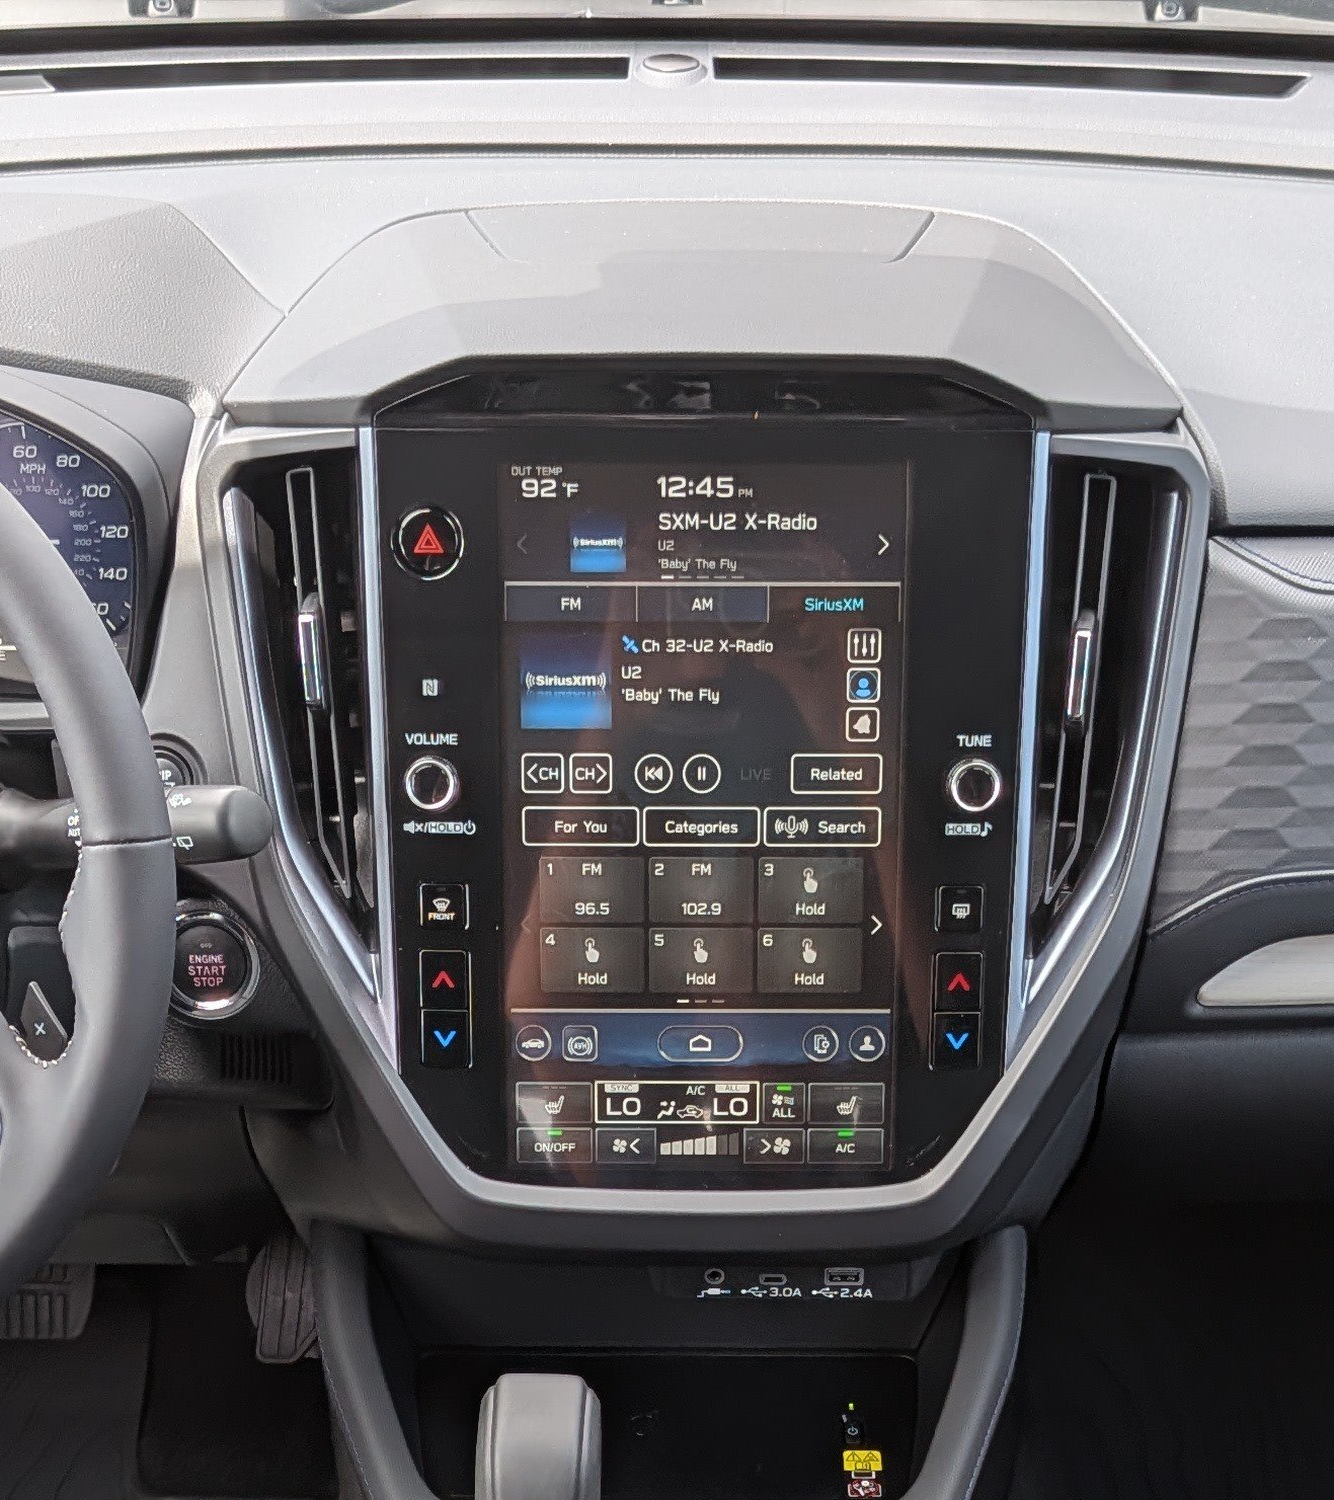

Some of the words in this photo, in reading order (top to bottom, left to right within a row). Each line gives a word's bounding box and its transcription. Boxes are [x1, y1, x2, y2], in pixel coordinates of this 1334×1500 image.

[13, 445, 37, 458] 60
[56, 454, 80, 467] 80
[20, 464, 46, 474] MPH
[511, 466, 532, 477] OUT
[535, 466, 563, 477] TEMP
[26, 485, 41, 493] 100
[44, 488, 59, 496] 120
[81, 484, 111, 498] 100
[521, 478, 557, 498] 92
[656, 476, 734, 498] 12:45
[738, 488, 753, 498] PM
[73, 524, 88, 532] 180
[658, 513, 737, 531] SXM-U2
[744, 513, 817, 531] X-Radio
[100, 526, 129, 539] 120
[74, 538, 92, 546] 200
[658, 541, 675, 551] U2
[74, 554, 91, 562] 220
[696, 558, 716, 569] The
[720, 558, 737, 571] Fly
[98, 567, 127, 581] 140
[561, 598, 581, 611] FM
[691, 598, 713, 611] AM
[804, 598, 864, 611] SiriusXM
[642, 640, 661, 652] Ch
[665, 640, 714, 652] 32-U2
[718, 640, 774, 652] X-Radio
[621, 666, 642, 680] U2
[621, 688, 662, 703] 'Baby'
[667, 689, 693, 702] The
[699, 689, 719, 703] Fly
[405, 733, 458, 746] VOLUME
[956, 735, 992, 747] TUNE
[538, 768, 559, 781] CH
[574, 768, 595, 781] CH
[740, 768, 772, 781] LIVE
[810, 768, 863, 781] Related
[555, 821, 578, 834] For
[584, 821, 608, 834] You
[665, 821, 738, 836] Categories
[818, 821, 866, 835] Search
[946, 823, 981, 835] HOLD
[547, 864, 554, 876] 1
[582, 864, 602, 876] FM
[655, 864, 664, 876] 2
[691, 864, 712, 876] FM
[764, 864, 774, 876] 3
[574, 903, 610, 916] 96.5
[681, 903, 722, 916] 102.9
[795, 903, 826, 916] Hold
[428, 912, 455, 921] FRONT
[545, 935, 556, 946] 4
[654, 935, 664, 947] 5
[763, 935, 773, 946] 6
[188, 954, 224, 964] ENGINE
[187, 965, 226, 976] START
[193, 977, 223, 987] STOP
[578, 972, 608, 985] Hold
[686, 972, 716, 985] Hold
[795, 972, 825, 985] Hold
[610, 1084, 633, 1092] SYNC
[685, 1085, 705, 1097] A/C
[724, 1084, 741, 1092] ALL
[606, 1097, 641, 1117] LO
[712, 1097, 748, 1117] LO
[771, 1107, 795, 1118] ALL
[534, 1142, 576, 1153] ON/OFF
[835, 1143, 855, 1153] A/C
[769, 1287, 802, 1298] 3.0A
[840, 1288, 873, 1299] 2.4A
